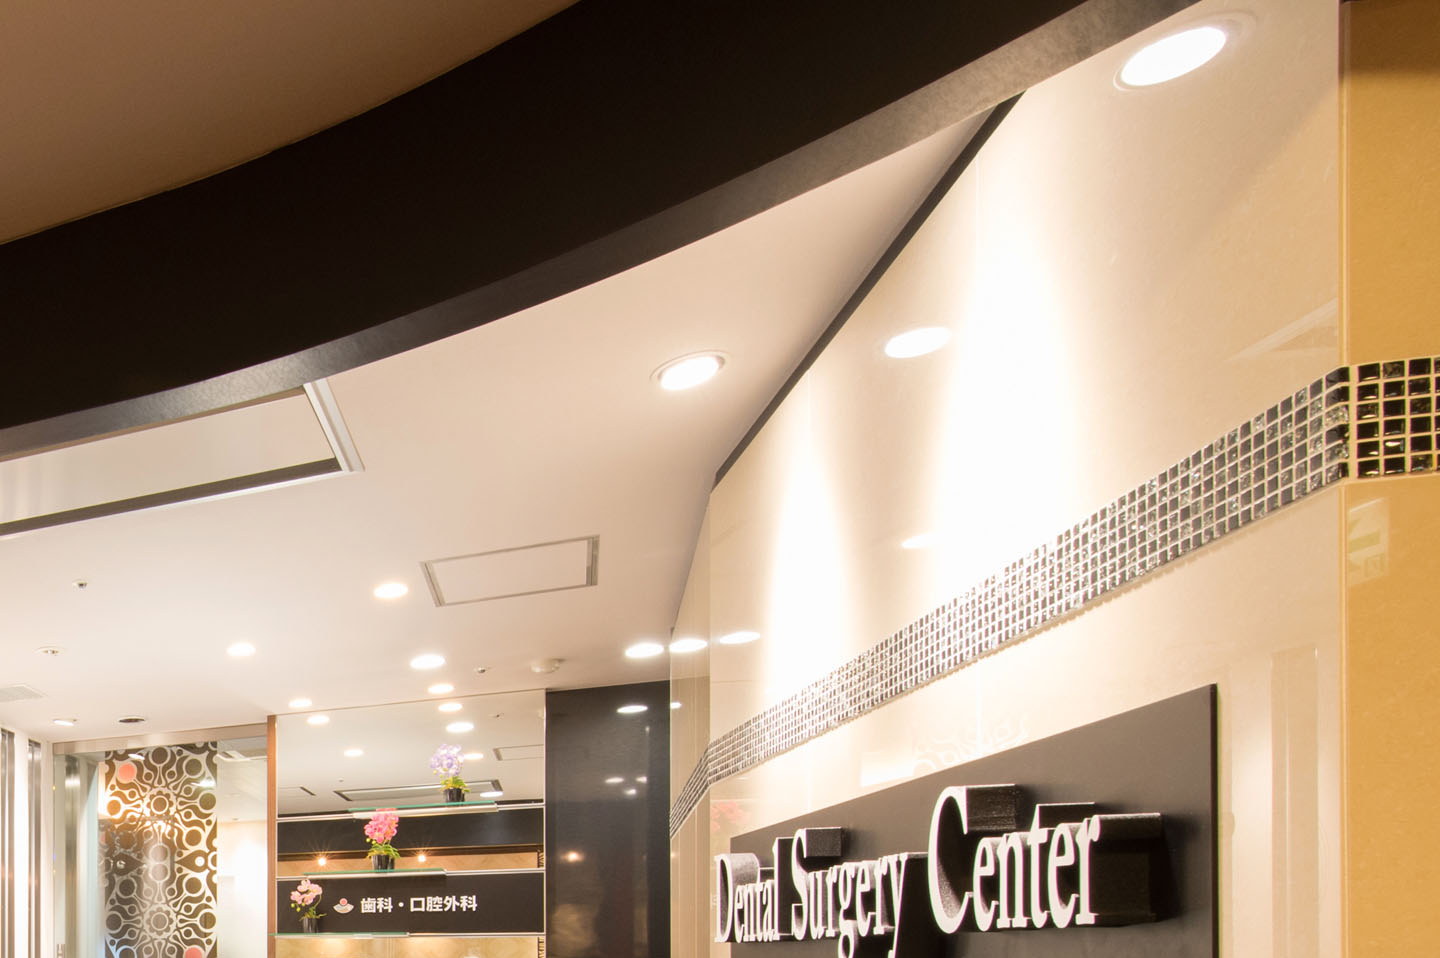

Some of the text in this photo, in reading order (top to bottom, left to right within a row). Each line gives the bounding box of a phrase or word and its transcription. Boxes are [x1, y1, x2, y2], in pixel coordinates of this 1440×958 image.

[360, 895, 478, 913] 歯科・口腔外科
[714, 836, 781, 943] Dental
[928, 785, 1101, 934] Center
